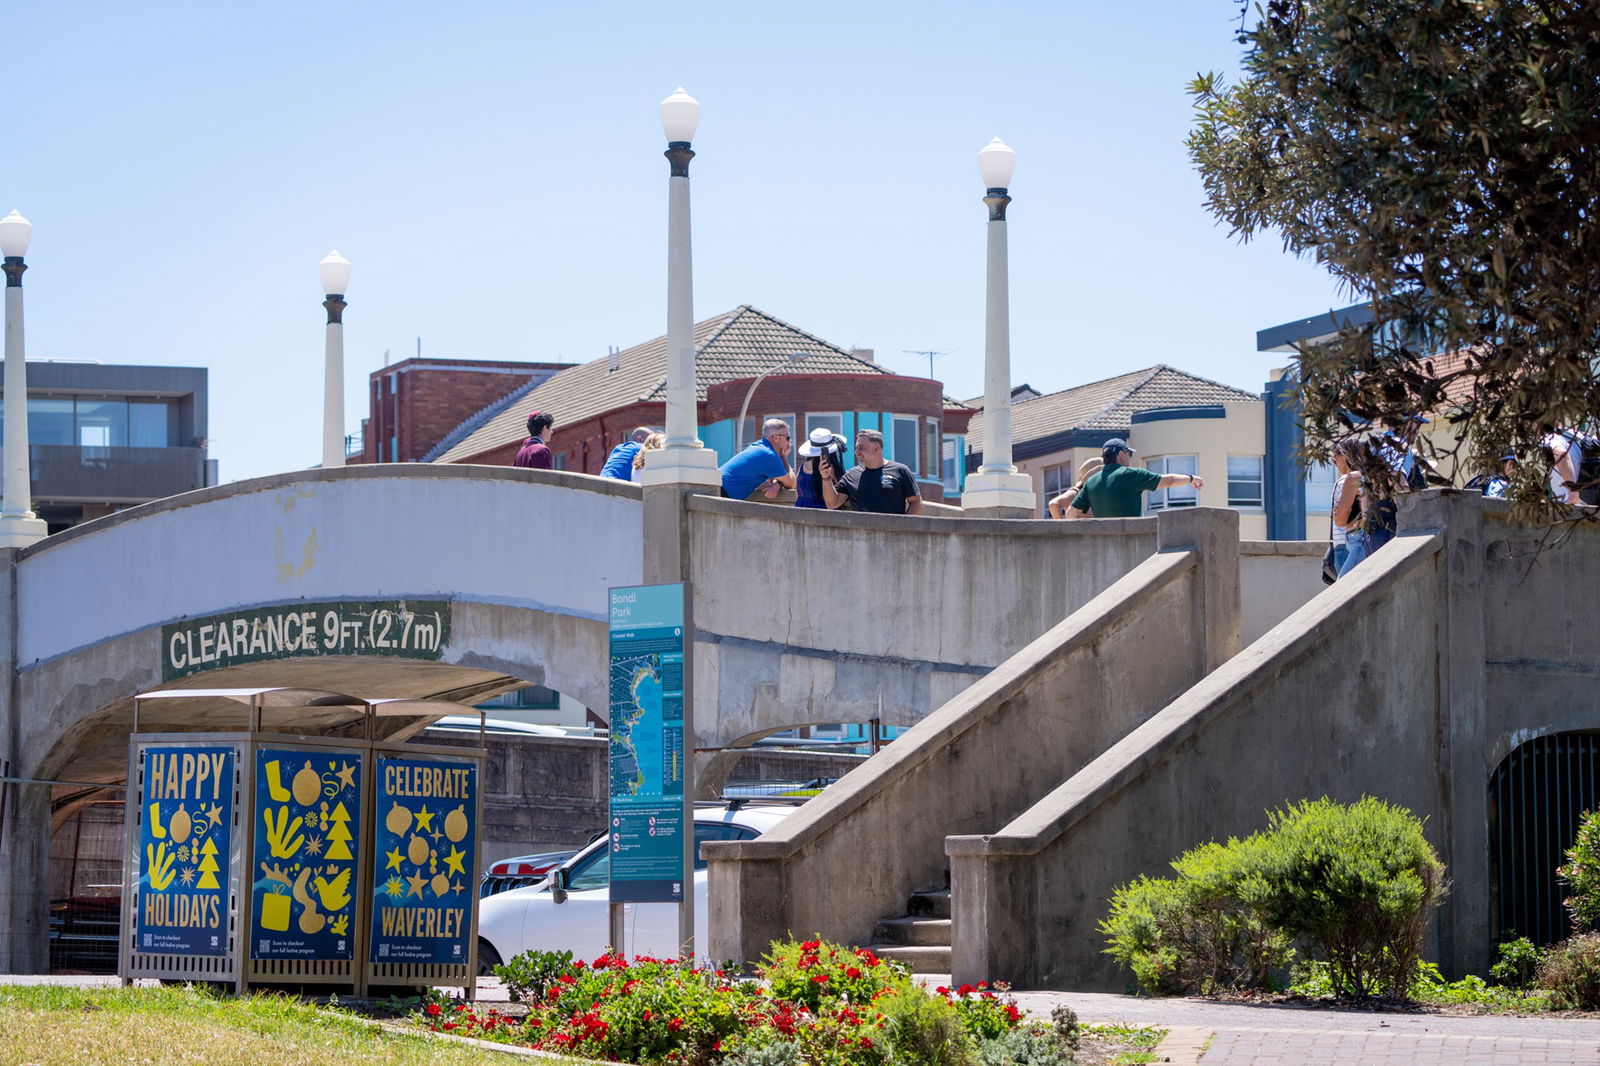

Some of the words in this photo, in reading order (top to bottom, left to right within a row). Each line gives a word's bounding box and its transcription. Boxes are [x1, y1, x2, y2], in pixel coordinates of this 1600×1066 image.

[612, 592, 636, 604] Bondi
[612, 606, 631, 617] Park
[169, 610, 317, 670] CLEARANCE
[150, 753, 226, 800] HAPPY
[384, 765, 470, 799] CELEBRATE
[145, 894, 220, 928] HOLIDAYS
[381, 906, 464, 938] WAVERLEY
